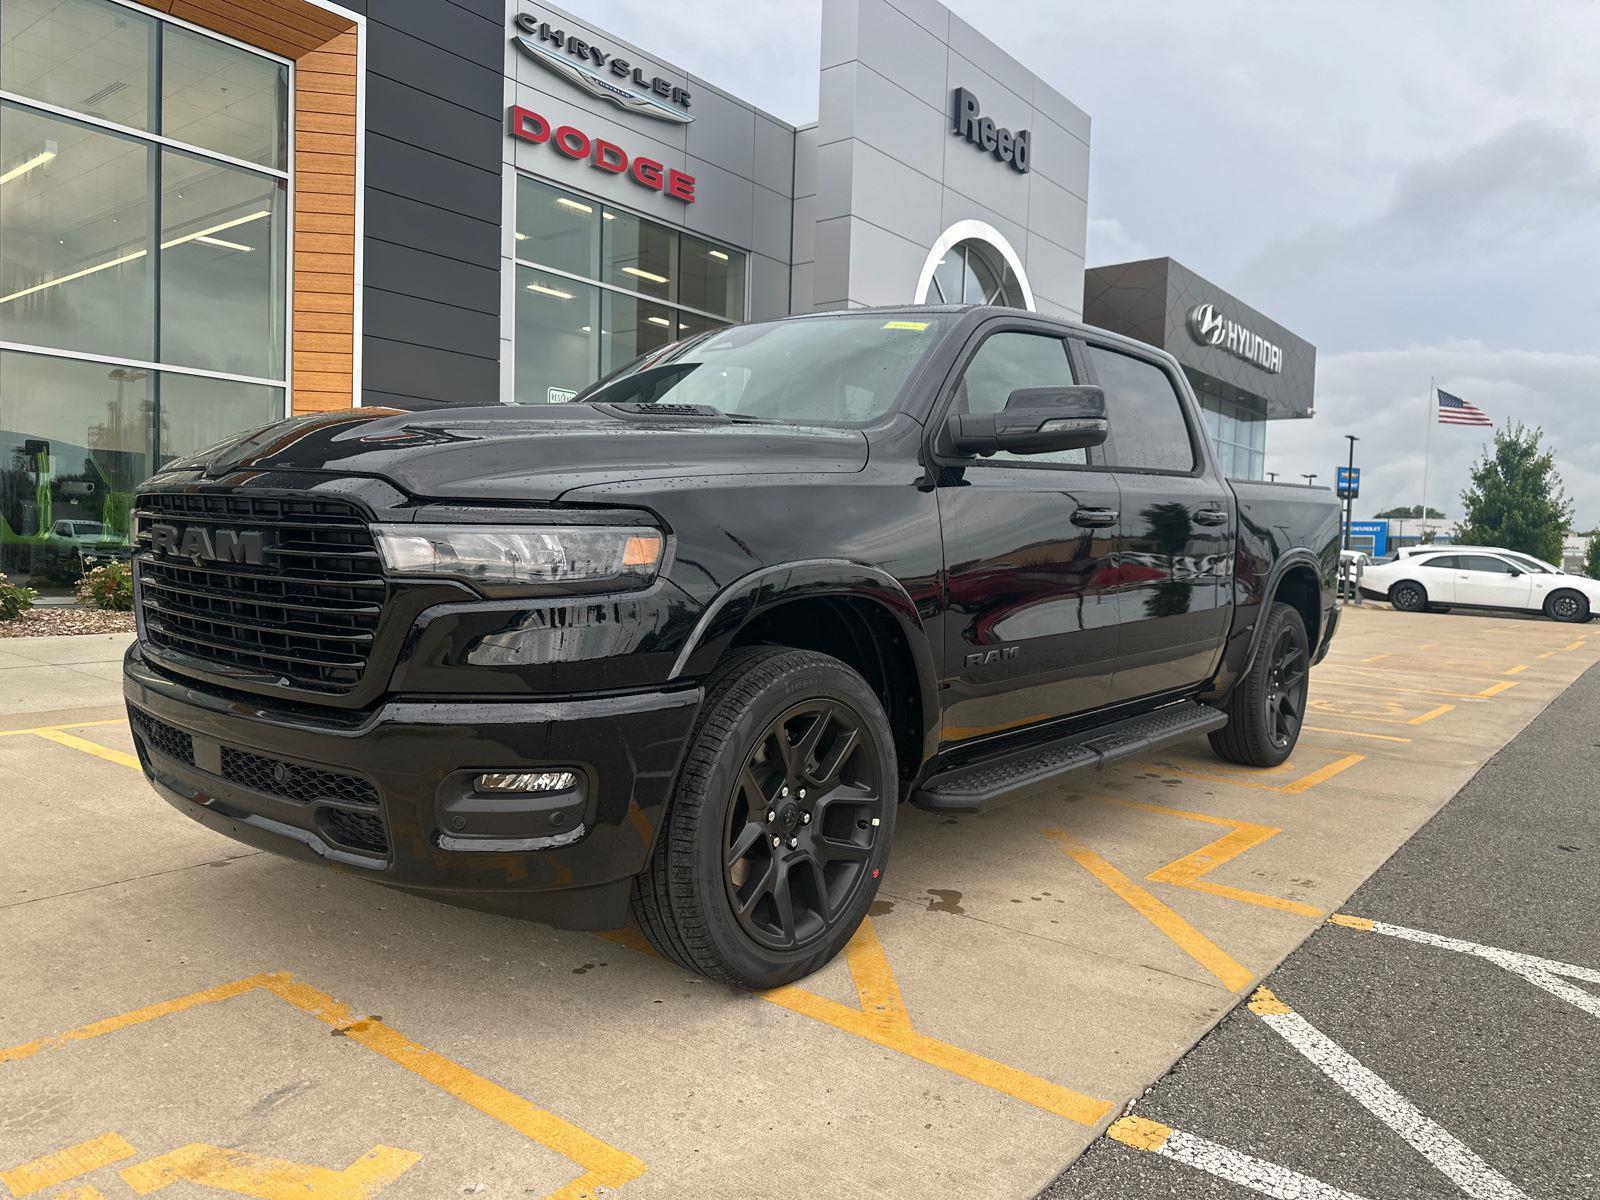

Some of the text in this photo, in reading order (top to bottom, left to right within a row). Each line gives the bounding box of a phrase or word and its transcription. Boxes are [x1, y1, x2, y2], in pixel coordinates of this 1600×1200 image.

[515, 12, 692, 107] CHRYSLER
[508, 105, 695, 204] DODGE
[954, 87, 1031, 174] Reed
[1227, 320, 1282, 374] HYUNDAI
[152, 523, 264, 566] RAM
[964, 646, 1019, 668] RAM
